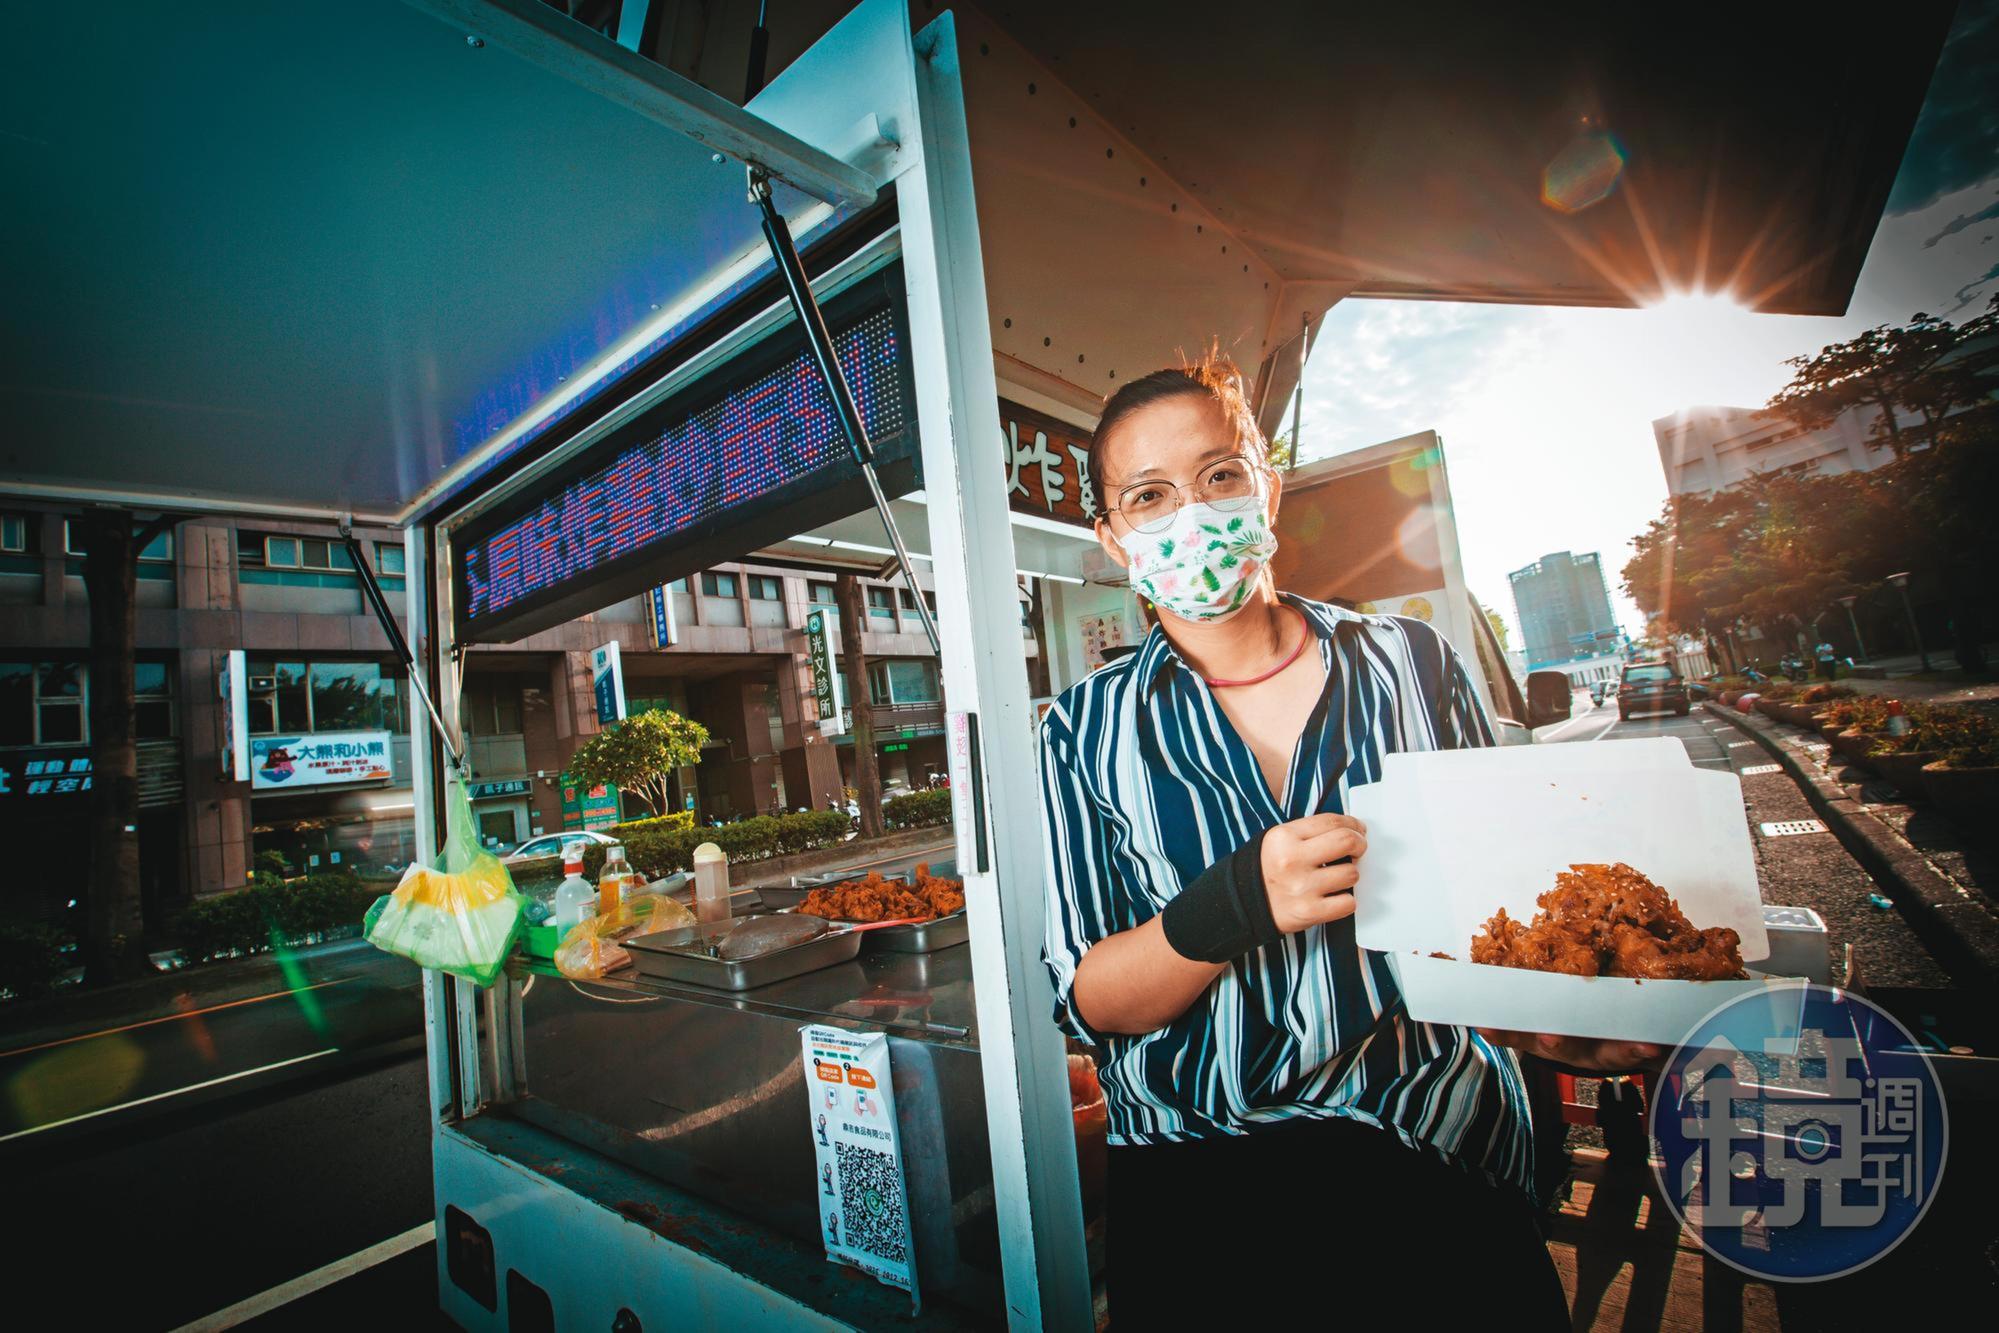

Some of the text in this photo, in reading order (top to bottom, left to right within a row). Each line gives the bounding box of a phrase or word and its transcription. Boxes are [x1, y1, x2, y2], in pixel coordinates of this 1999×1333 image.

[811, 635, 832, 717] 光文診所
[296, 741, 384, 761] 大熊和小熊
